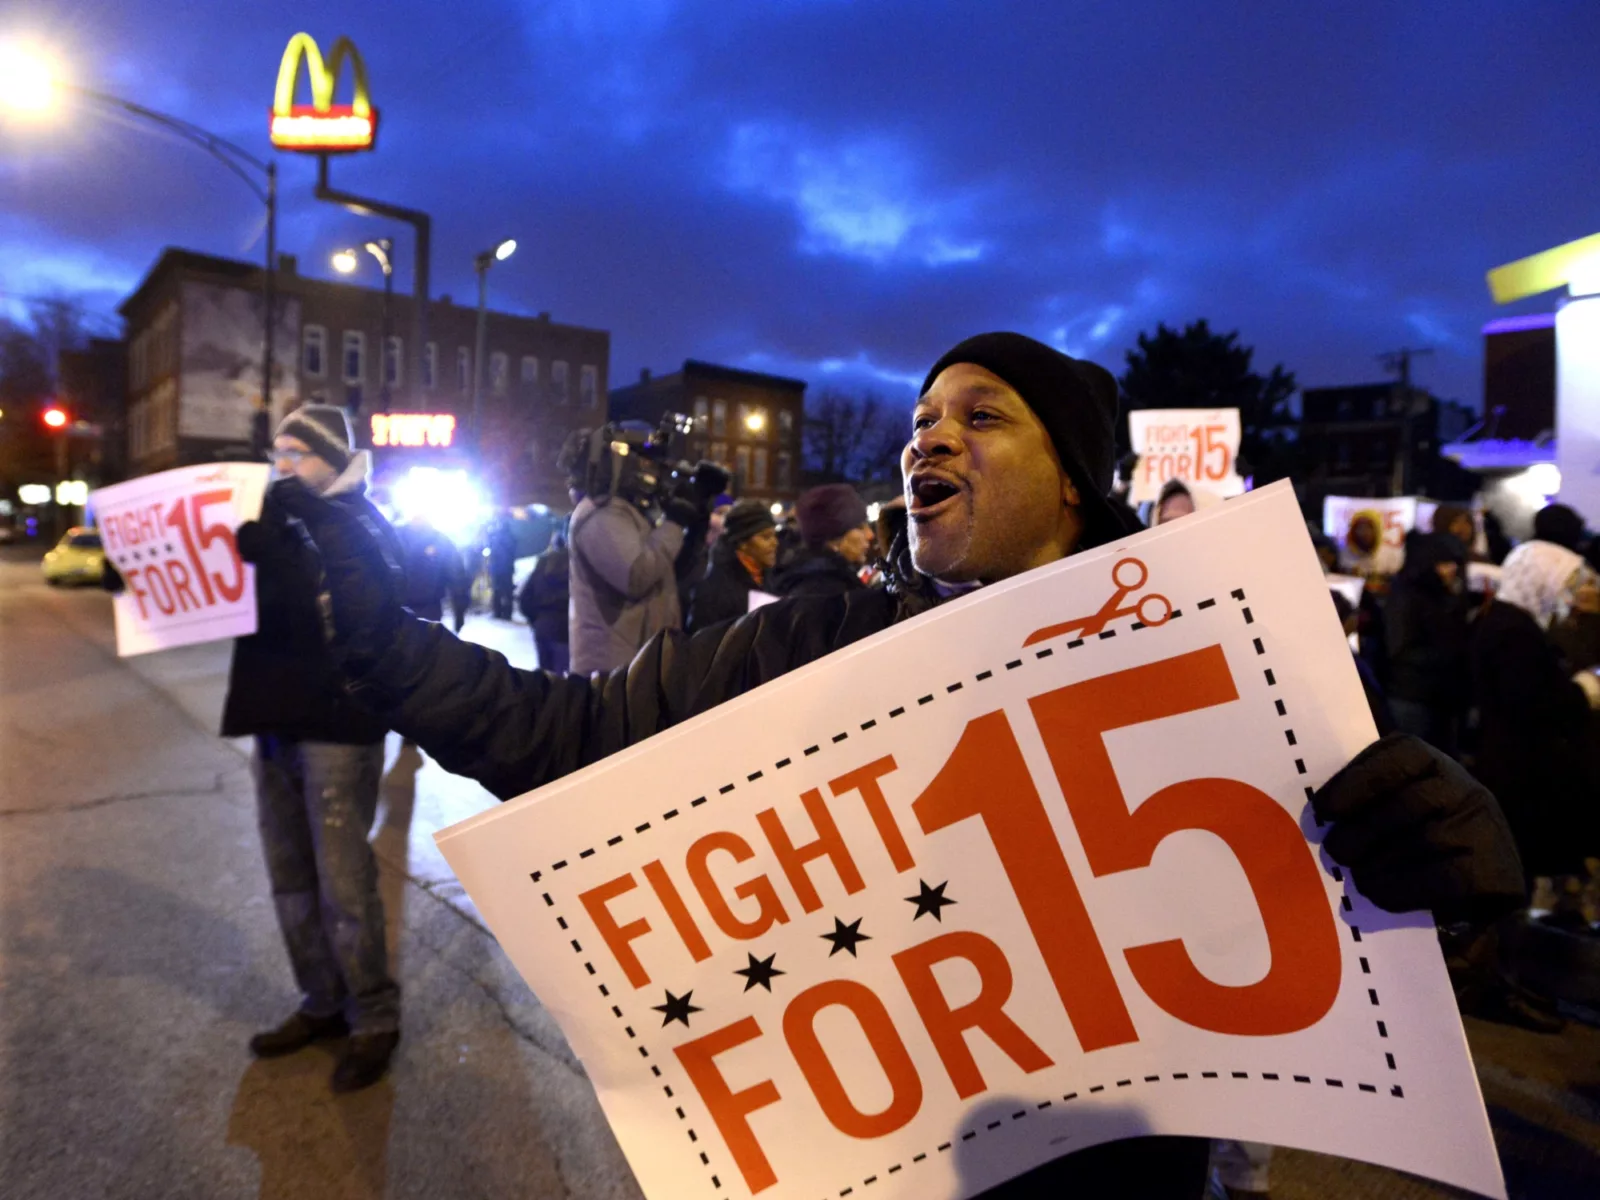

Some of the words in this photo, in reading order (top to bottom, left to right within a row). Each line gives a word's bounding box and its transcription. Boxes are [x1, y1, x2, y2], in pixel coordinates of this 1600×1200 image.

[1145, 453, 1193, 485] FOR
[1189, 424, 1231, 481] 15
[103, 503, 167, 550] FIGHT
[125, 559, 201, 621] FOR
[166, 488, 244, 606] 15
[578, 753, 917, 991] FIGHT
[673, 929, 1055, 1196] FOR
[911, 643, 1342, 1053] 15
